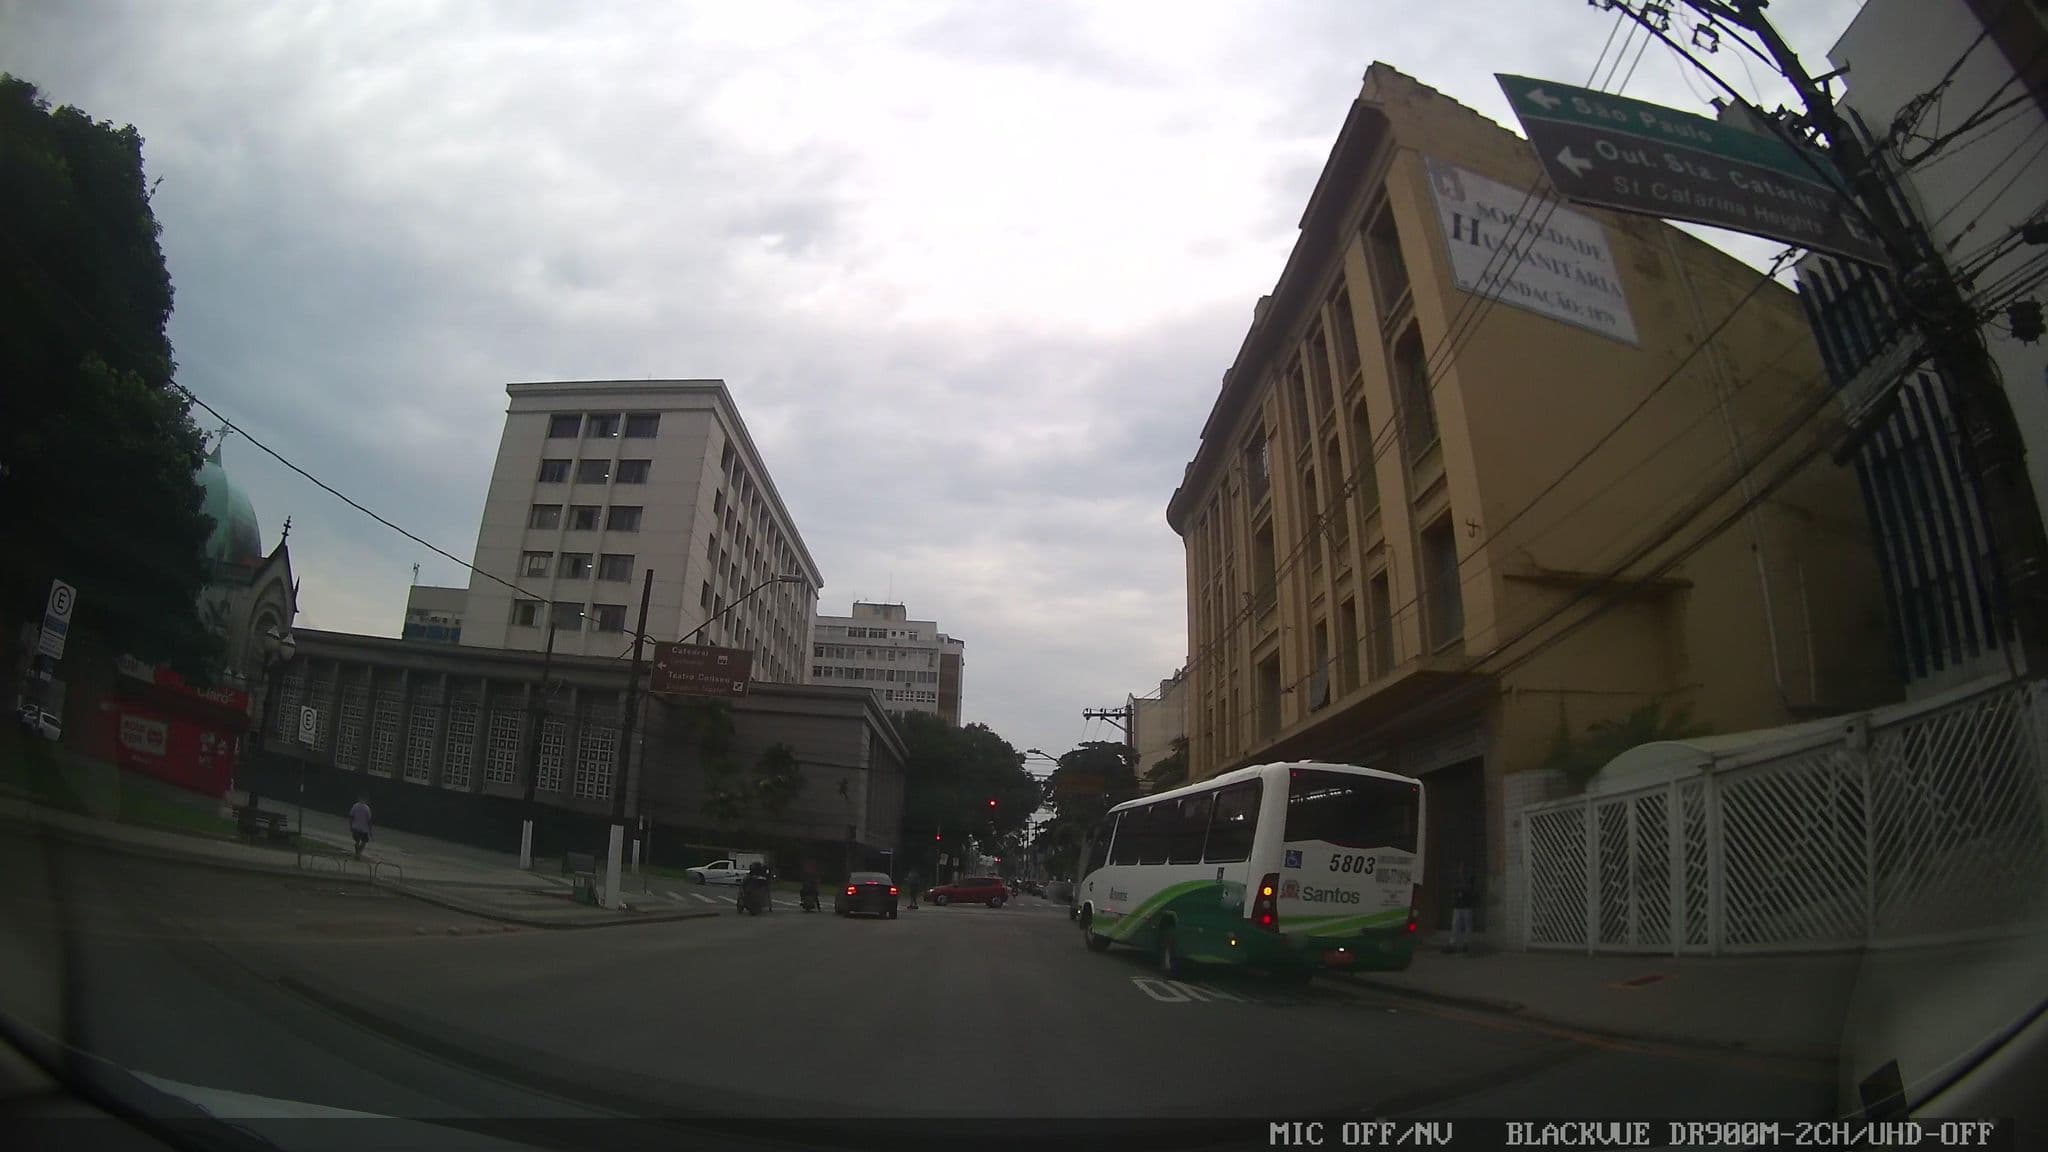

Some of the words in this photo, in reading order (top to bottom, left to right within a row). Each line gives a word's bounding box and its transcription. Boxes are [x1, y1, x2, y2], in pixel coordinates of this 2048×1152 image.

[1639, 111, 1713, 143] Paulo
[1476, 200, 1607, 264] SOCIEDADE
[1329, 852, 1376, 875] 5803
[1302, 885, 1361, 905] Santos
